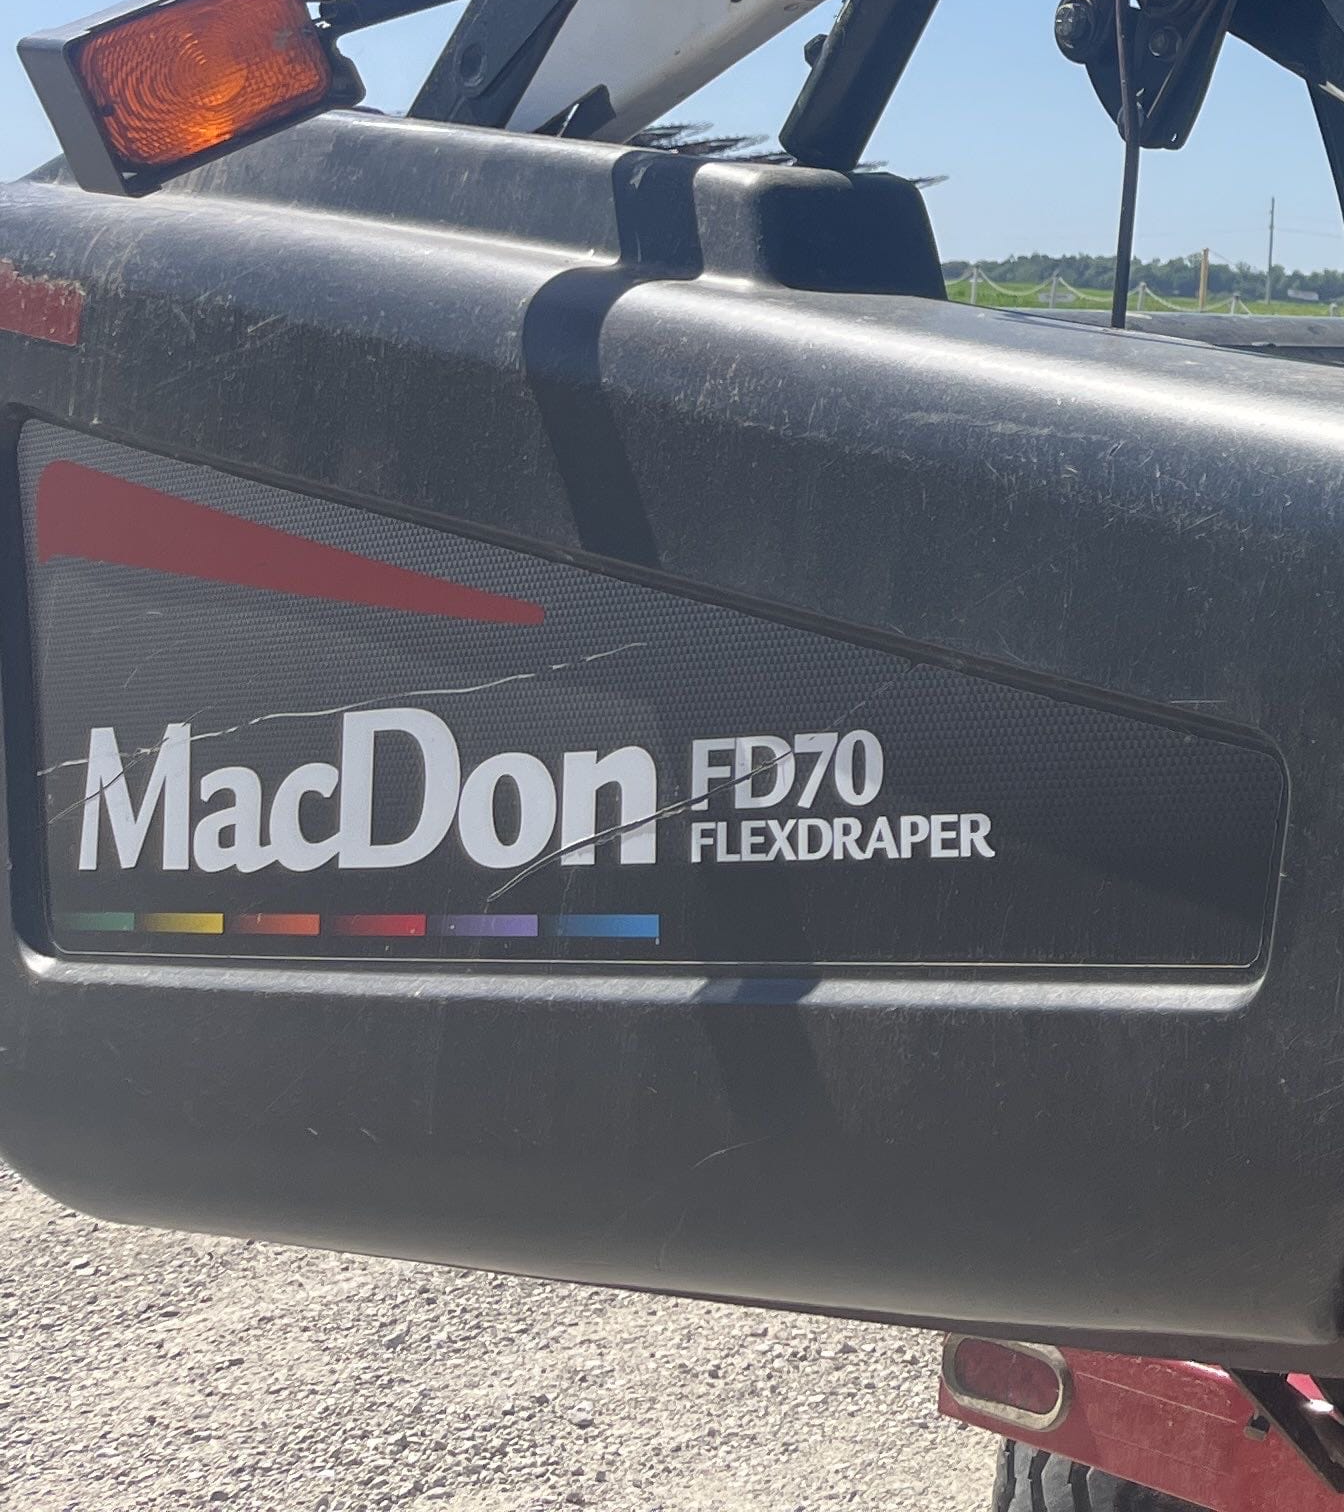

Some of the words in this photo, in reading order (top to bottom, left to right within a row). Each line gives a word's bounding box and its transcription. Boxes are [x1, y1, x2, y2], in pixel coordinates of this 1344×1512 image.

[78, 707, 658, 873] MacDon
[690, 729, 884, 811] FD70
[690, 813, 996, 864] FLEXDRAPER
